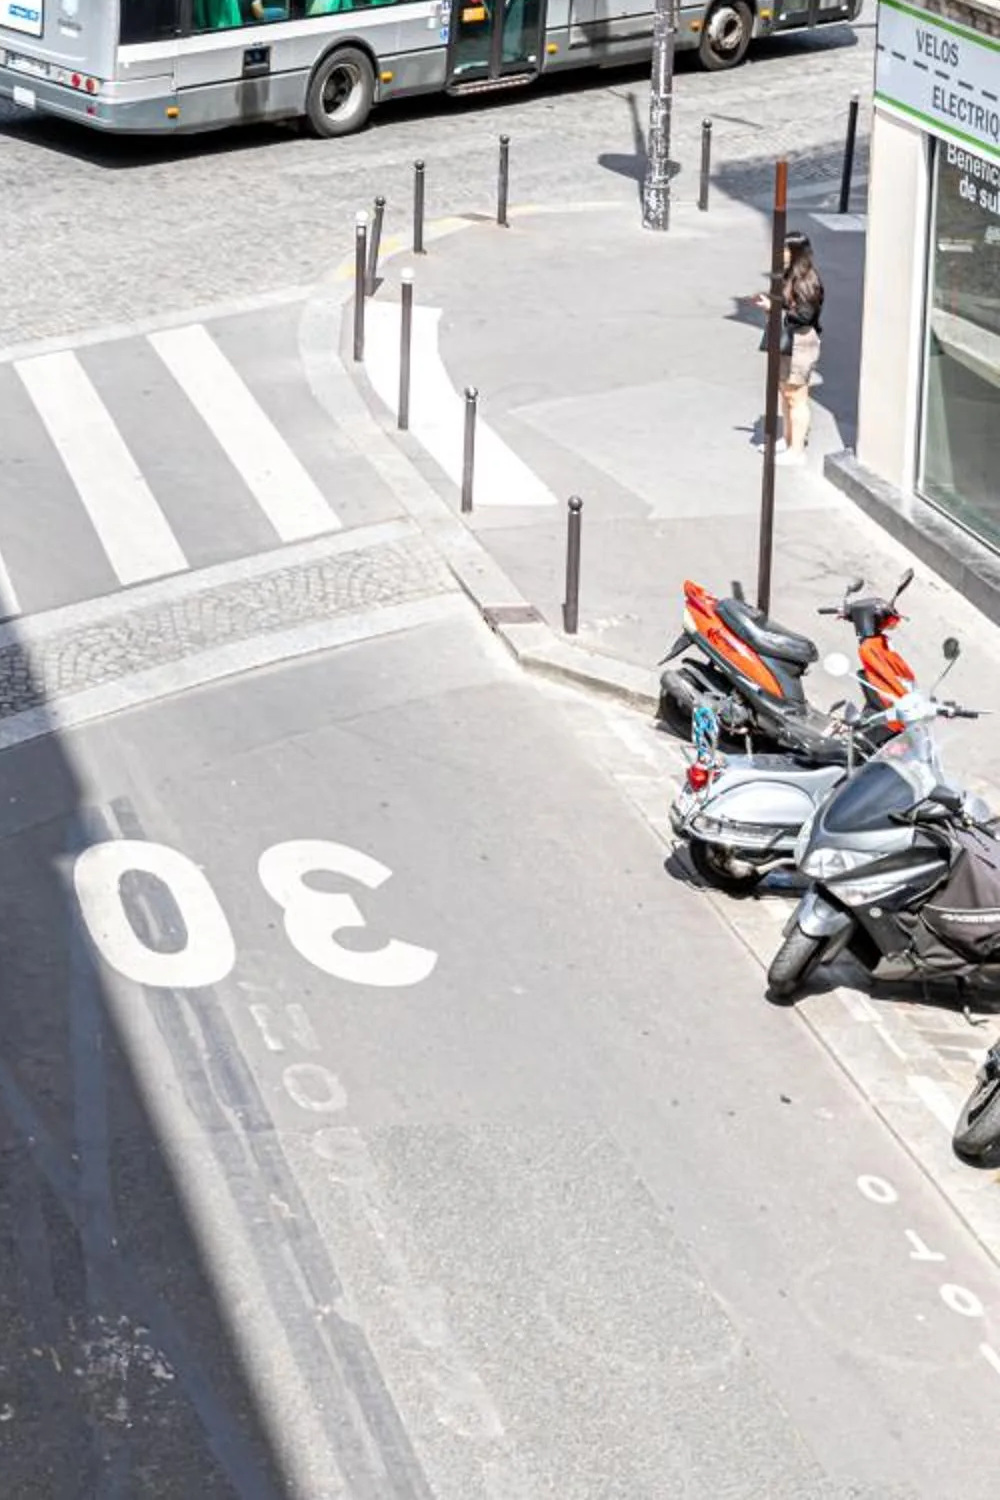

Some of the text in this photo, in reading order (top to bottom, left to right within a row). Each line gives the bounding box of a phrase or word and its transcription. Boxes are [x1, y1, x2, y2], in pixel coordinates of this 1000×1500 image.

[916, 28, 959, 68] VELOS
[932, 85, 1000, 143] ELECTRIQ
[960, 175, 977, 202] de
[73, 839, 438, 987] 30
